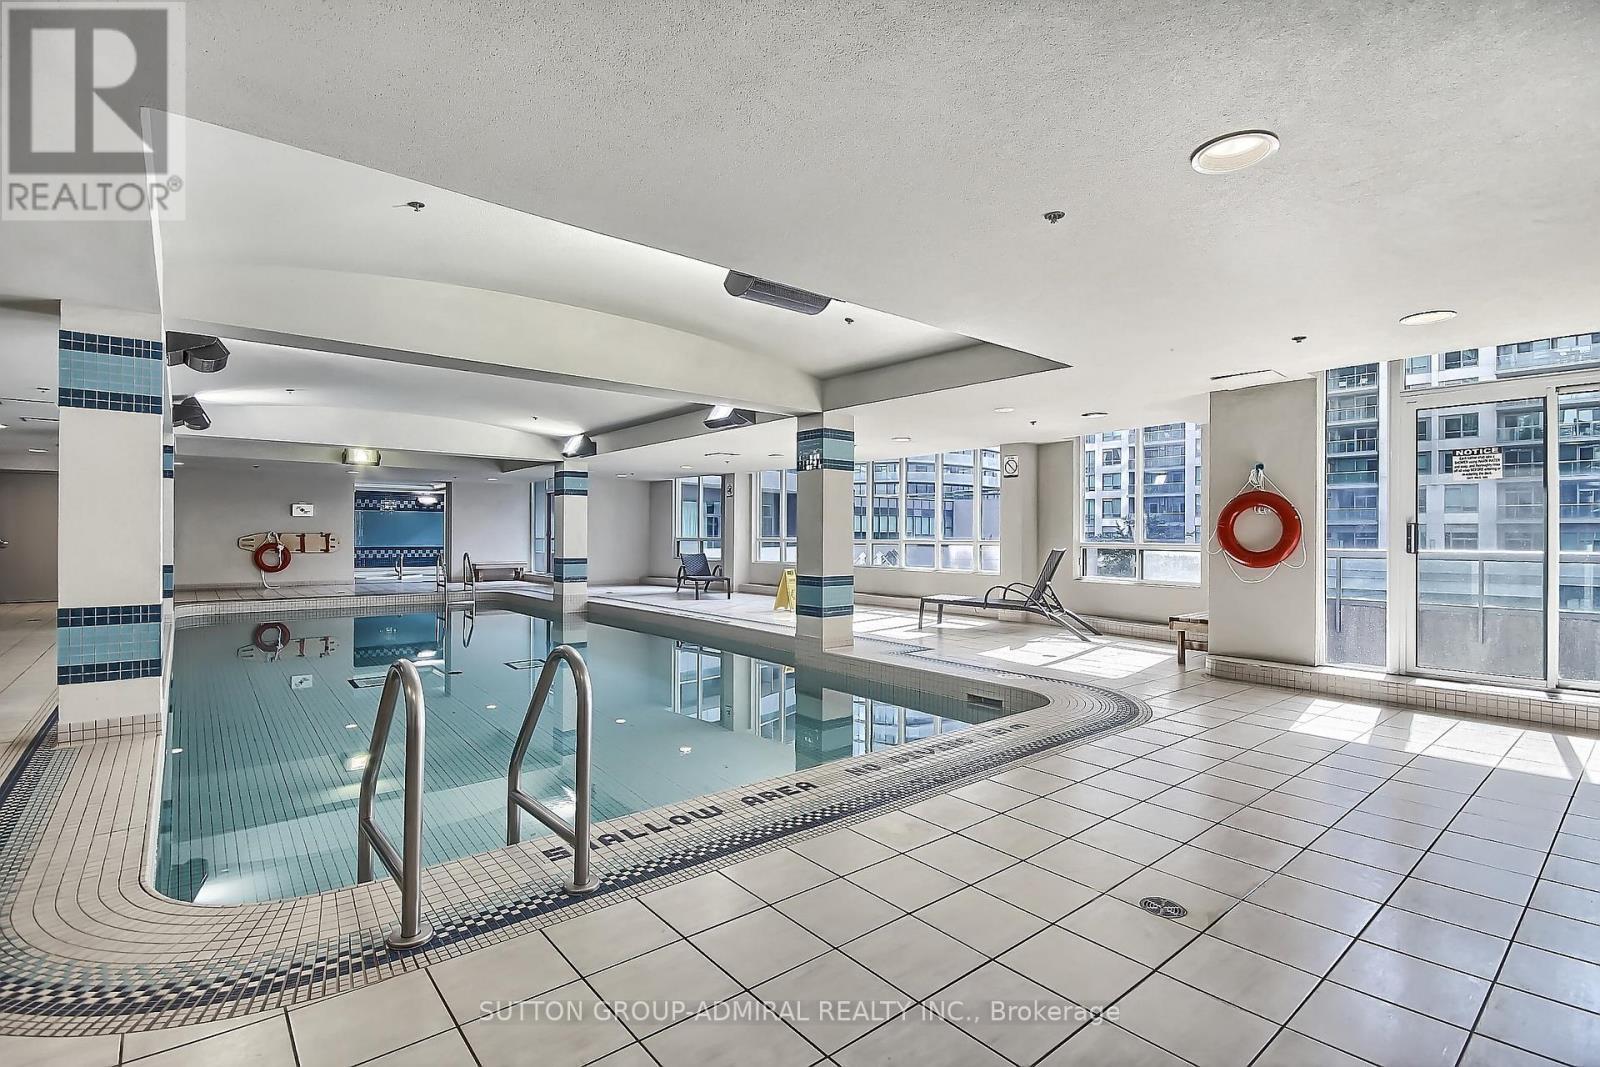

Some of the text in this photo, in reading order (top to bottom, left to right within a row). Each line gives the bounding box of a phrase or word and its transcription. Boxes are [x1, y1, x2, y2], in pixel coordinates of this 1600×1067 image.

[1455, 447, 1499, 456] NOTICE
[541, 804, 724, 862] SALLOW
[740, 780, 820, 808] AREA
